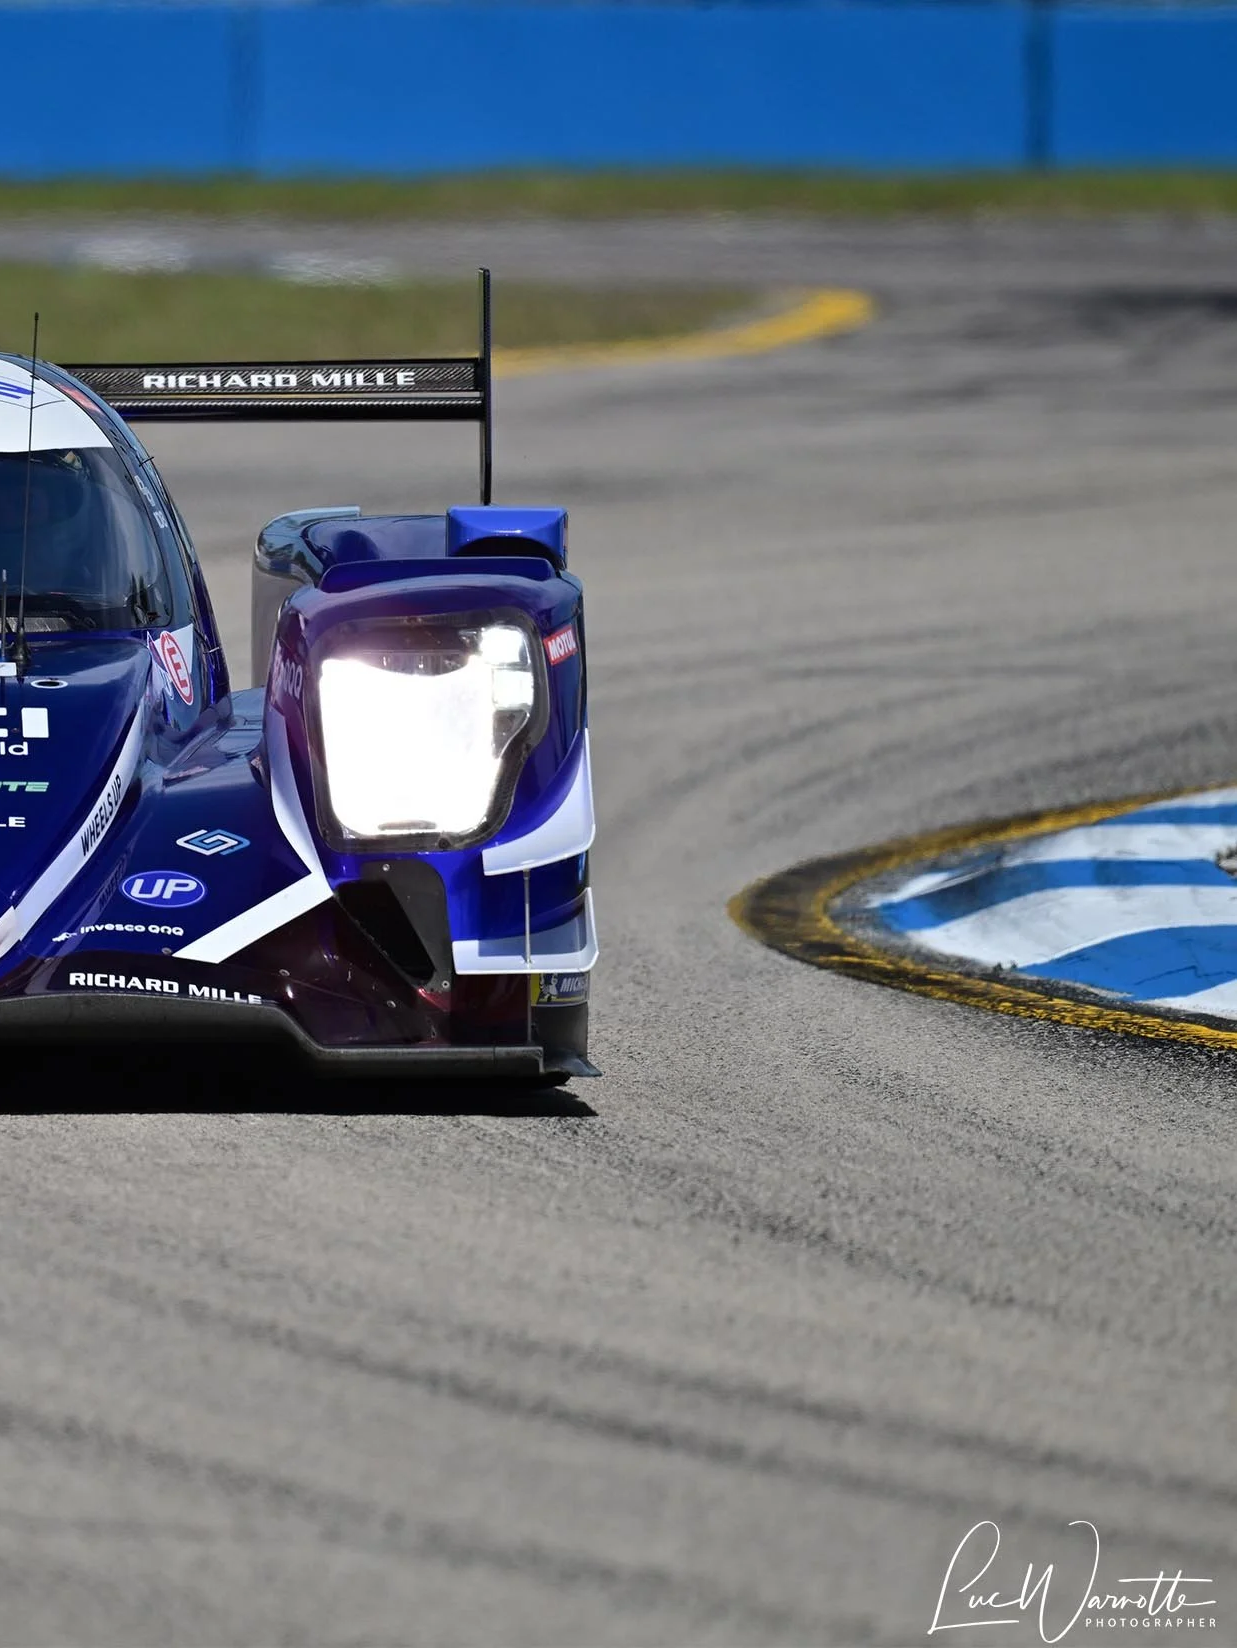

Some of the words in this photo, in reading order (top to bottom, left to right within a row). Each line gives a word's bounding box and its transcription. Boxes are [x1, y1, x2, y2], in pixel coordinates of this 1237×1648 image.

[143, 373, 297, 389] RICHARD
[312, 372, 415, 387] MILLE
[547, 629, 577, 661] MOTUL
[80, 793, 113, 857] WHEELS
[111, 774, 122, 807] UP
[130, 878, 197, 899] UP
[80, 923, 146, 934] Invesco
[148, 925, 184, 936] QQQ
[69, 973, 179, 994] RICHARD
[188, 984, 262, 1005] MILLE
